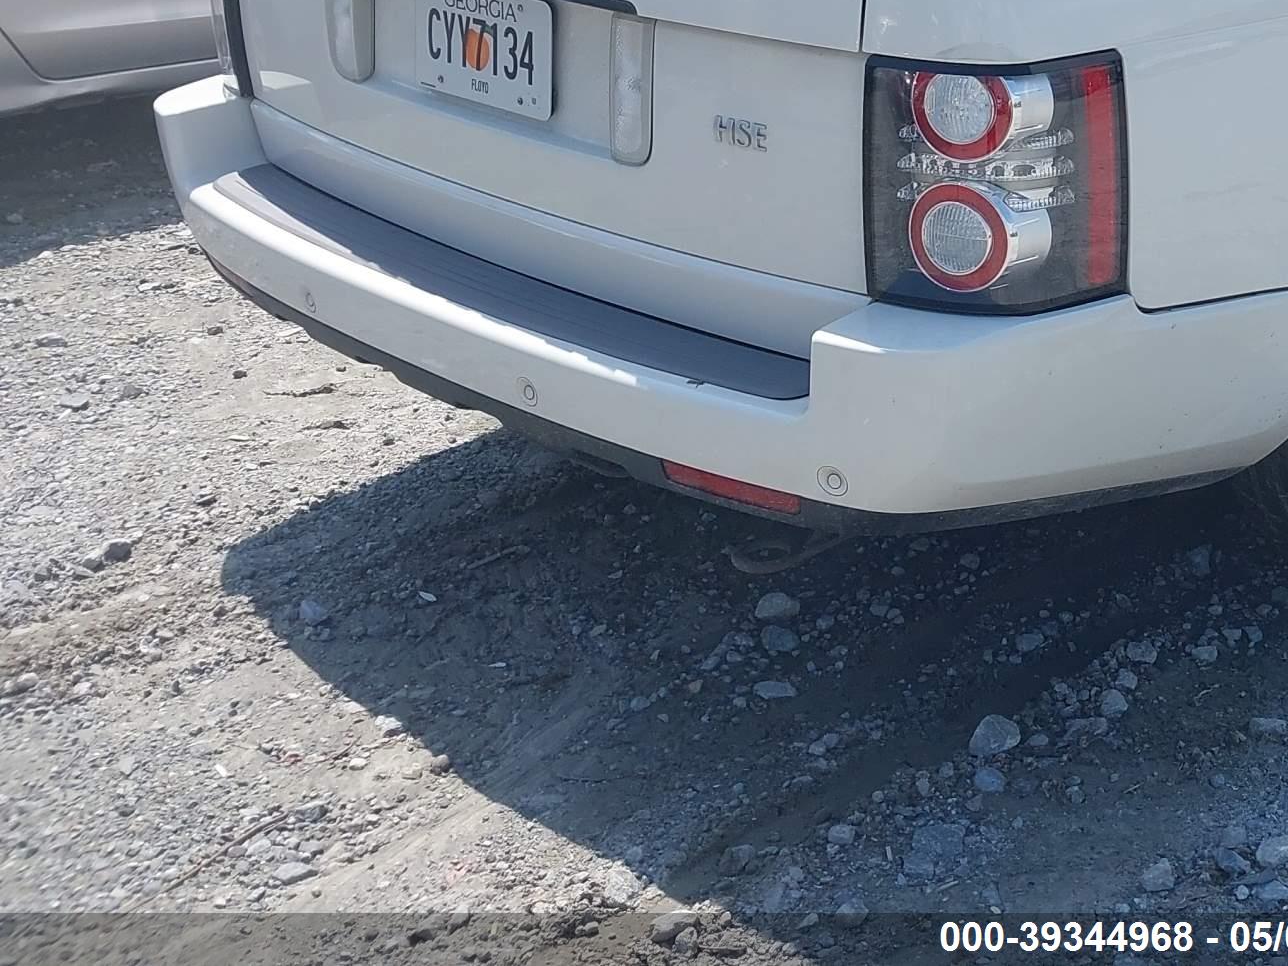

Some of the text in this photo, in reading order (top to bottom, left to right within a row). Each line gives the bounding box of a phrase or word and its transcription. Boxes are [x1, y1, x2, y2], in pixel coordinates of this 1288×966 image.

[428, 7, 534, 86] CYY7134
[471, 78, 489, 94] FLOYD
[713, 114, 768, 153] HSE
